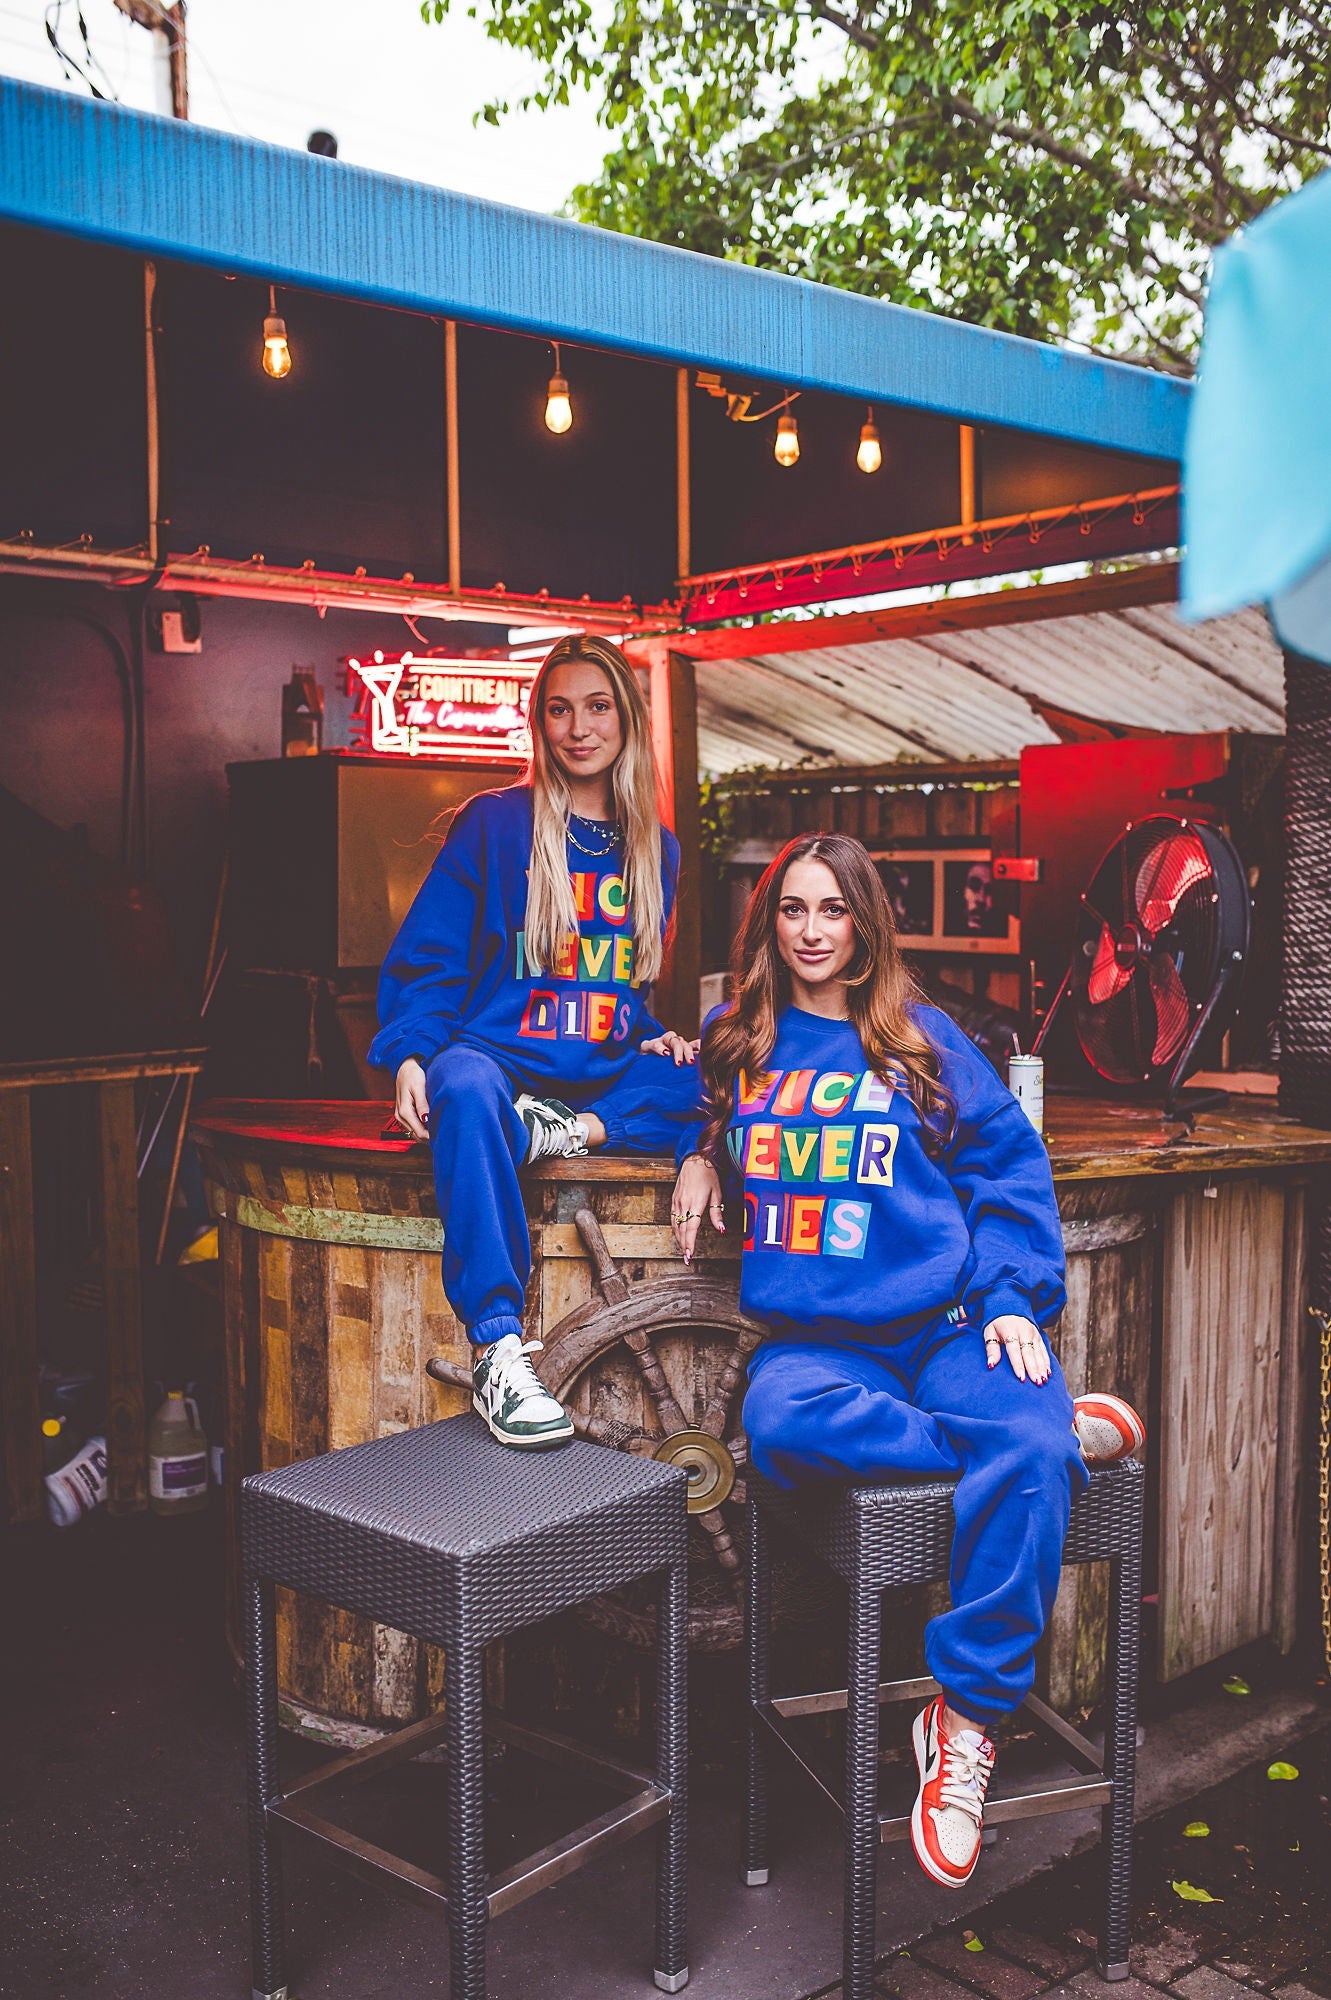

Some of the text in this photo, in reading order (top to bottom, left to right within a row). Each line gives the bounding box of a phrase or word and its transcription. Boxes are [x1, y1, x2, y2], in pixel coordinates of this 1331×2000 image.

[420, 675, 519, 706] COINTREAU
[518, 989, 631, 1043] DIES
[738, 1069, 897, 1117] VICE
